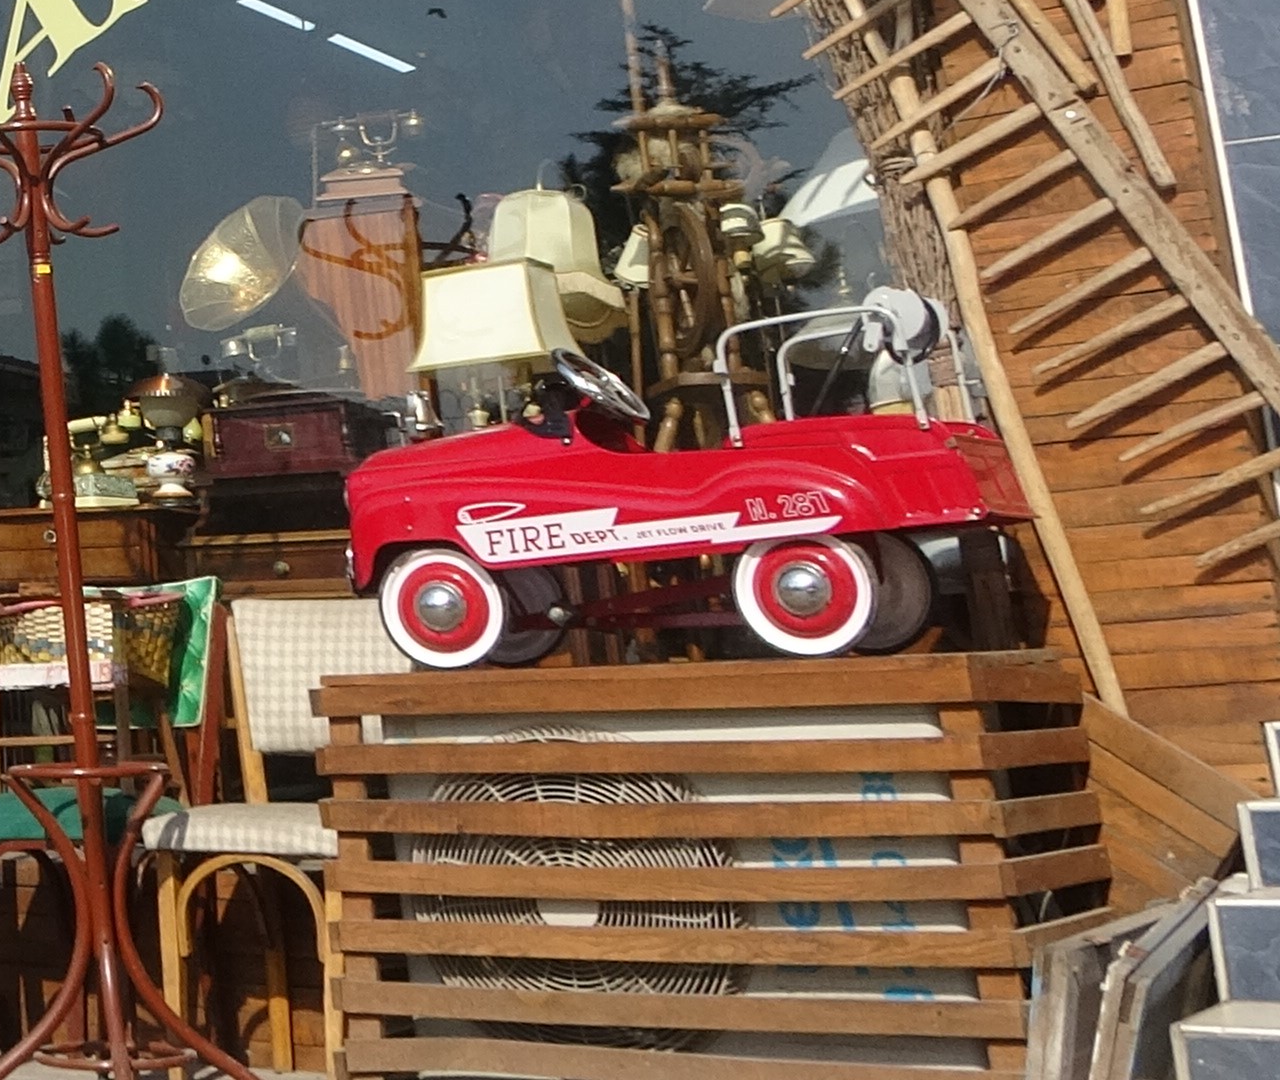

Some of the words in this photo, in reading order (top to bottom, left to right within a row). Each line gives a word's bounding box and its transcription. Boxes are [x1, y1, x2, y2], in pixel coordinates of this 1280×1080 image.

[485, 523, 566, 556] FIRE
[570, 527, 629, 546] DEPT.
[656, 526, 688, 538] FLOW
[690, 522, 726, 534] DRIVE
